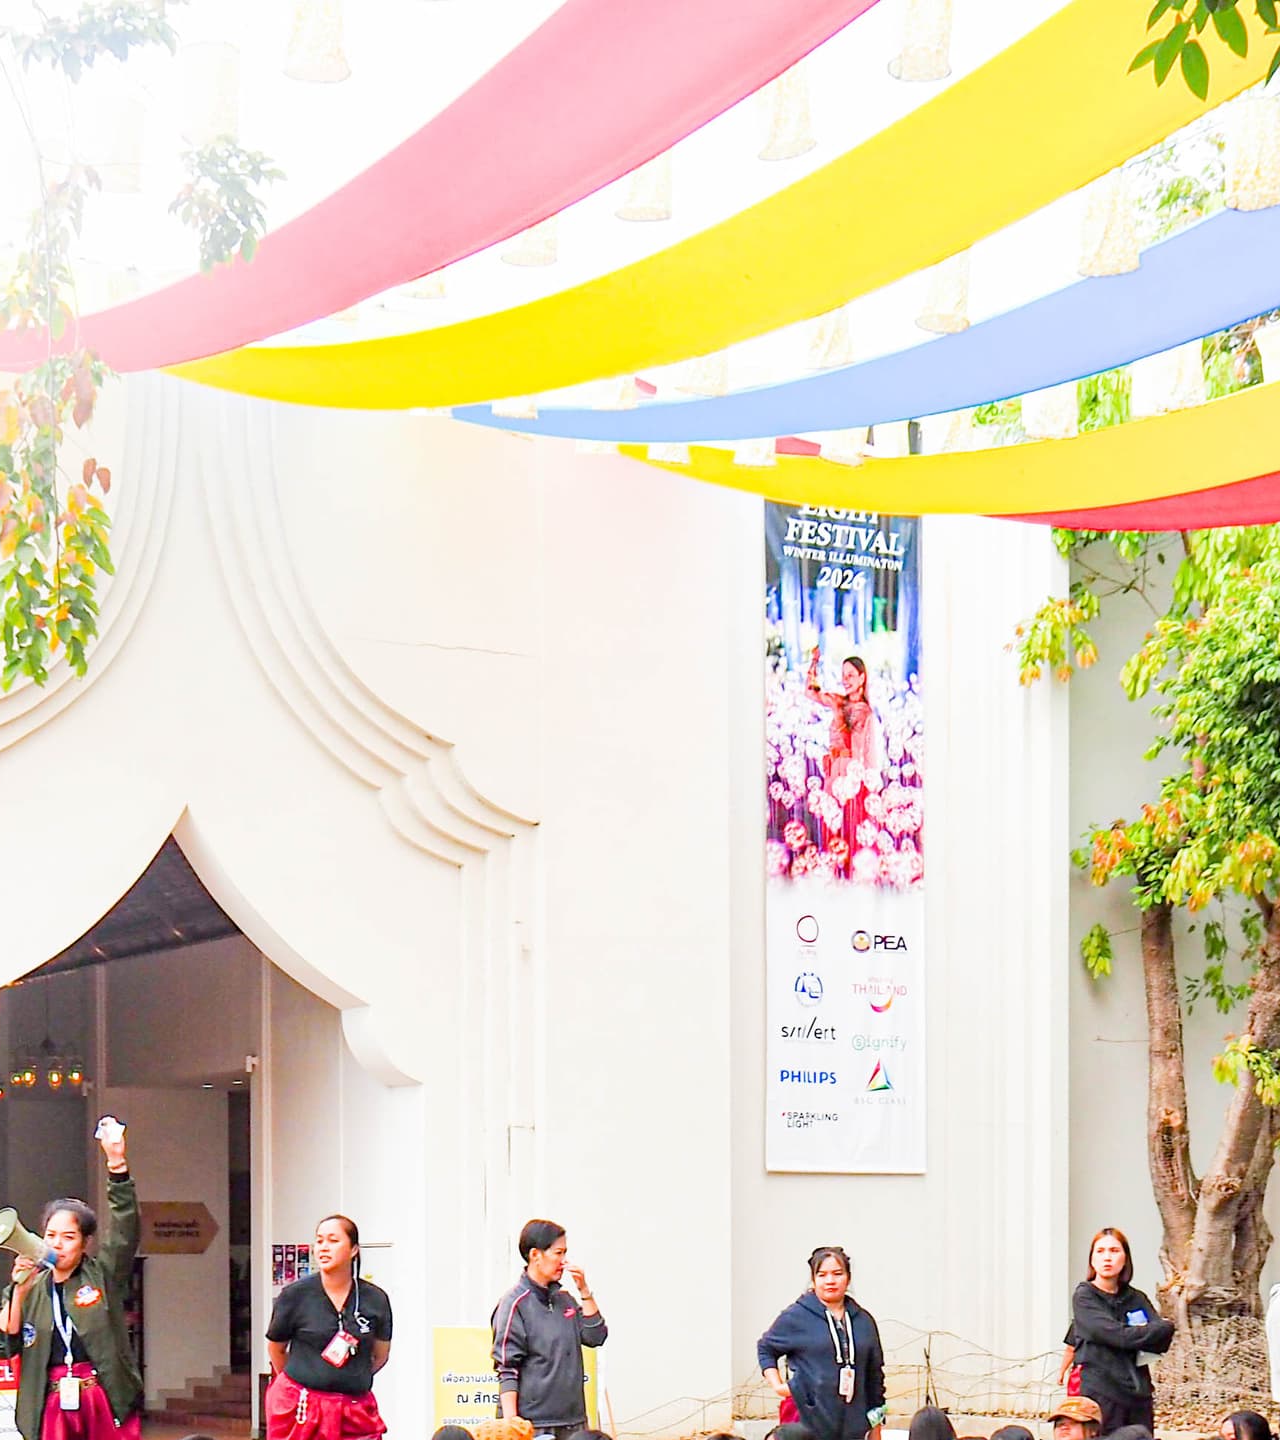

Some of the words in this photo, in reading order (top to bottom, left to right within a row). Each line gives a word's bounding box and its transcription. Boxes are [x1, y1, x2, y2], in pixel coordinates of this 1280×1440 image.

[784, 517, 905, 556] FESTIVAL
[783, 544, 826, 562] WINTER
[816, 566, 866, 590] 2026
[873, 935, 907, 951] PEA
[853, 982, 908, 997] THAILAND
[780, 1069, 837, 1085] PHILIPS
[787, 1111, 839, 1122] SPARKLING
[787, 1119, 814, 1129] LIGHT
